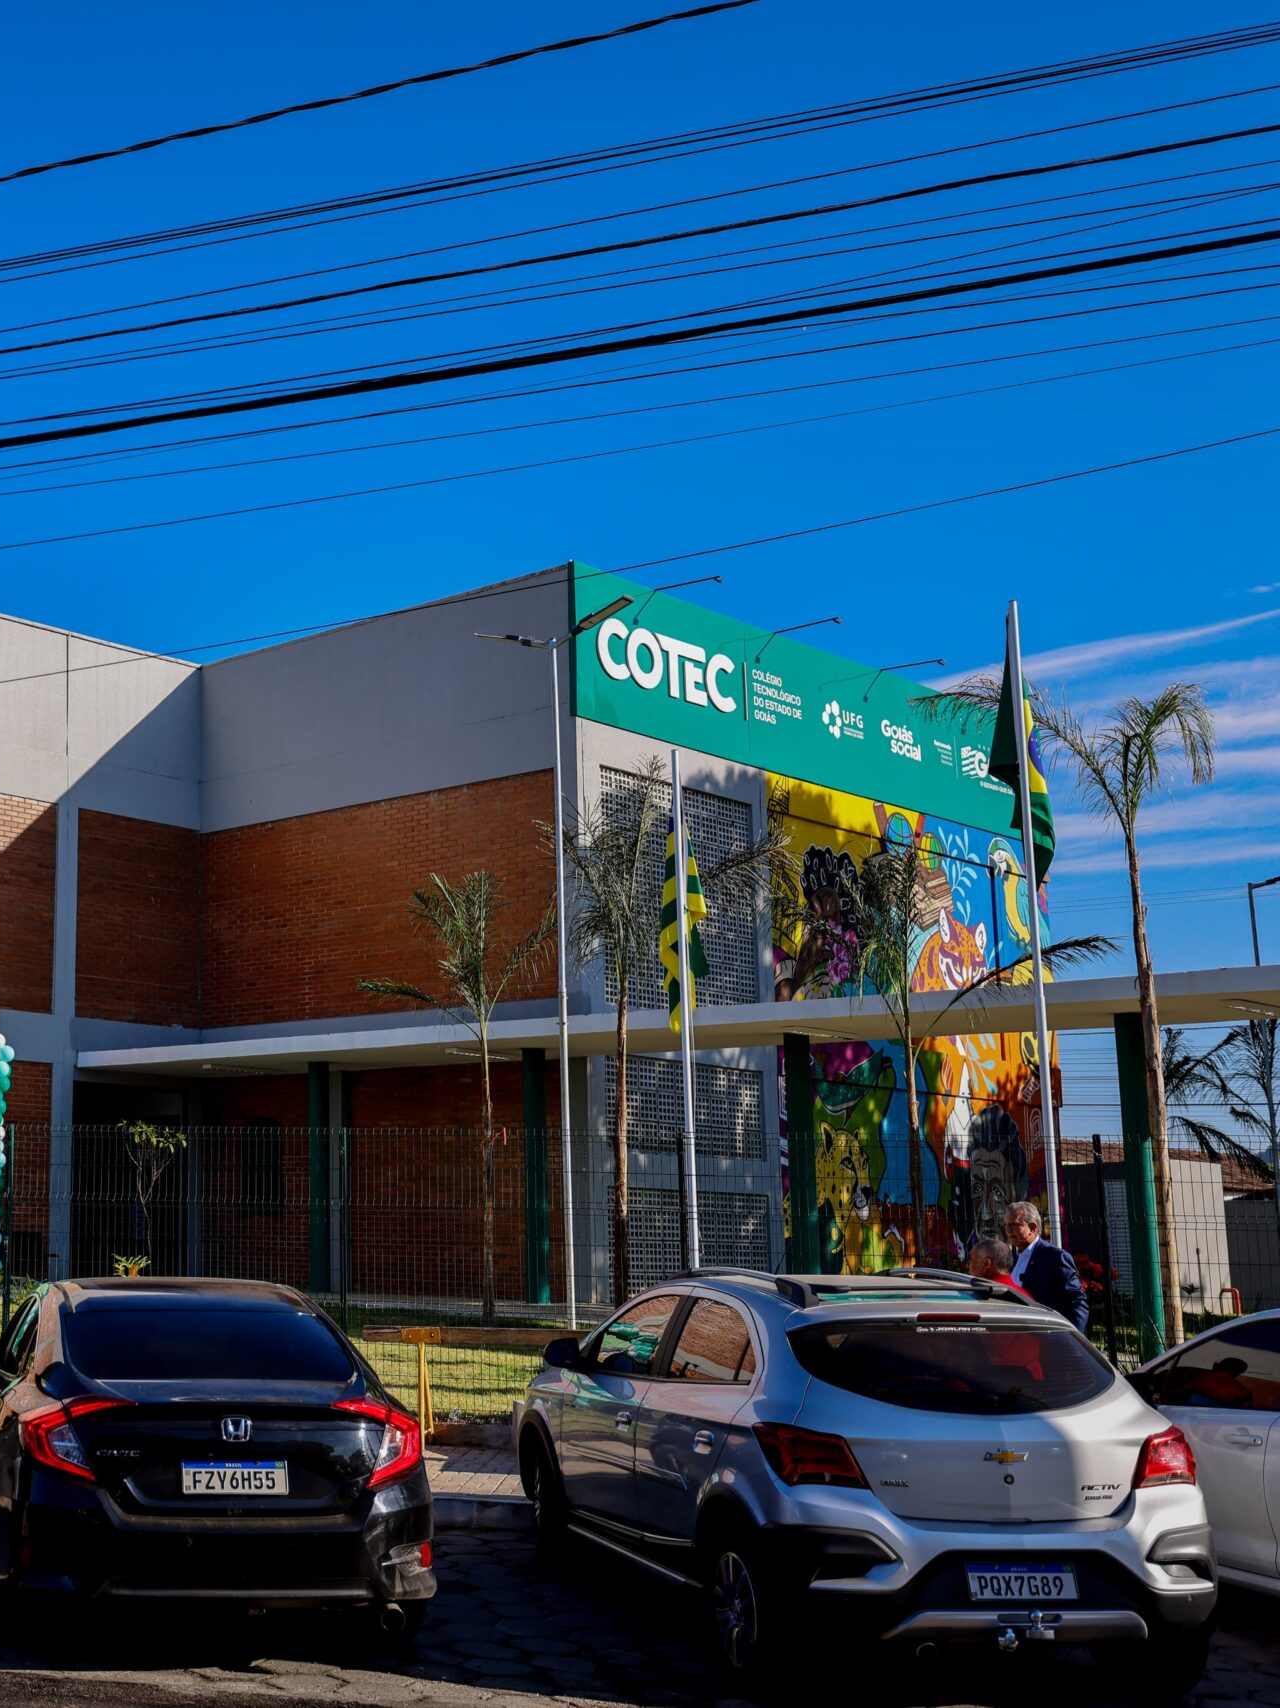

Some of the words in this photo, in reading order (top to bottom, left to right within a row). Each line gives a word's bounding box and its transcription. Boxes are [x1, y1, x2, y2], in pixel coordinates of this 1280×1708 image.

[597, 618, 737, 713] COTEC
[752, 669, 782, 687] COLÉGIO
[753, 682, 801, 706] TECNOLÓGICO
[754, 696, 764, 708] DO
[765, 702, 792, 716] ESTADO
[793, 709, 803, 720] DE
[754, 710, 777, 724] GOIÁS
[842, 710, 864, 728] UFG
[881, 719, 914, 744] Goiás
[96, 1449, 140, 1457] CIVIC
[192, 1470, 276, 1490] FZY6H55
[1081, 1483, 1123, 1491] ACTIV
[977, 1575, 1064, 1597] PQX7G89
